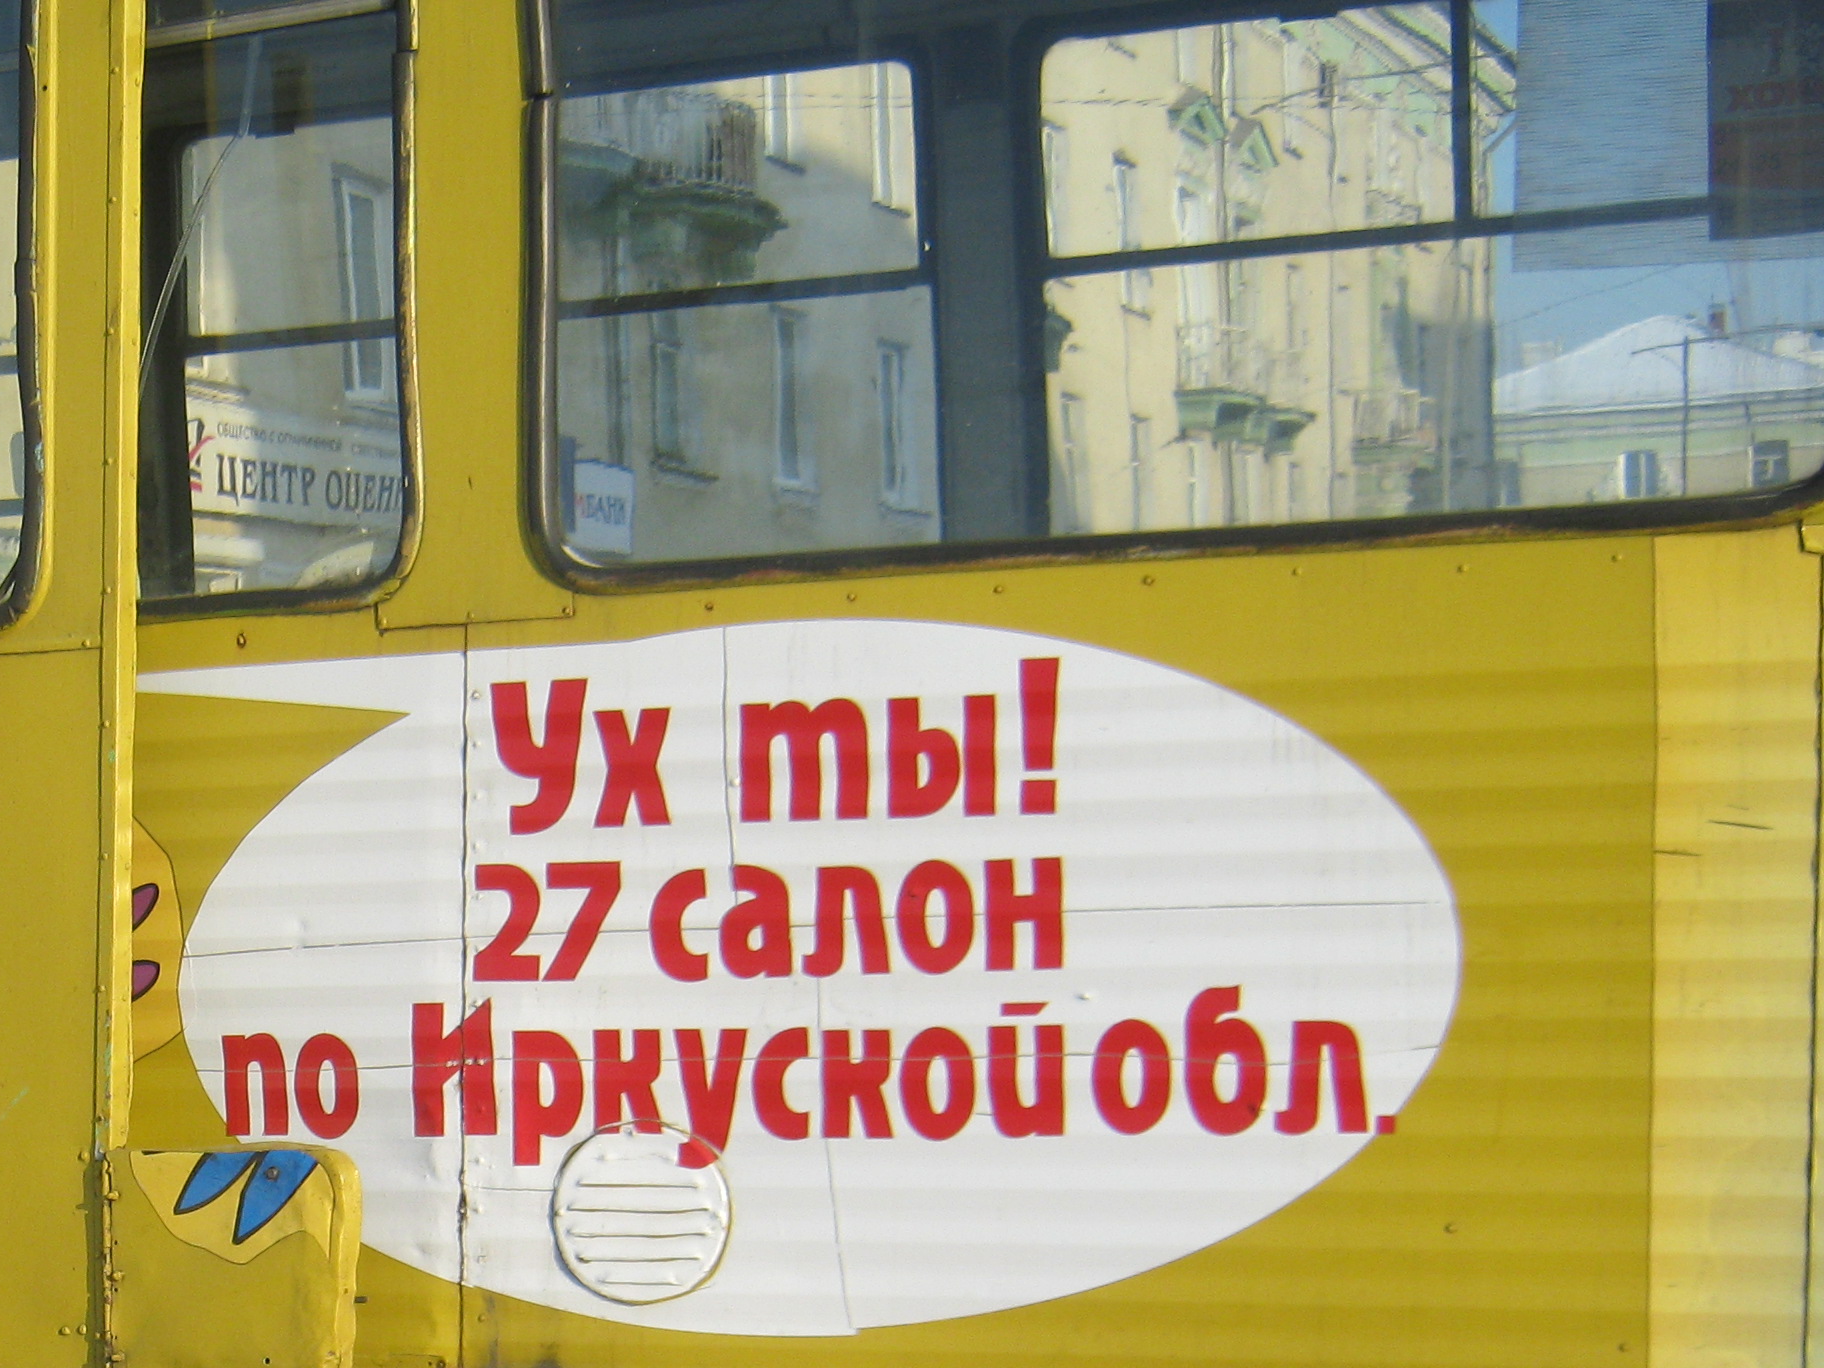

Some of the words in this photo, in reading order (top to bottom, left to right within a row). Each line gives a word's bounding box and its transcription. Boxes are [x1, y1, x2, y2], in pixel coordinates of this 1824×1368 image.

[217, 453, 316, 506] ЦЕНТР
[490, 678, 672, 835] Ух
[739, 657, 1060, 823] ты!
[472, 861, 621, 982] 27
[649, 857, 1063, 983] салон
[222, 1033, 359, 1139] по
[412, 997, 1064, 1169] Иркуской
[1091, 985, 1397, 1136] обл.
